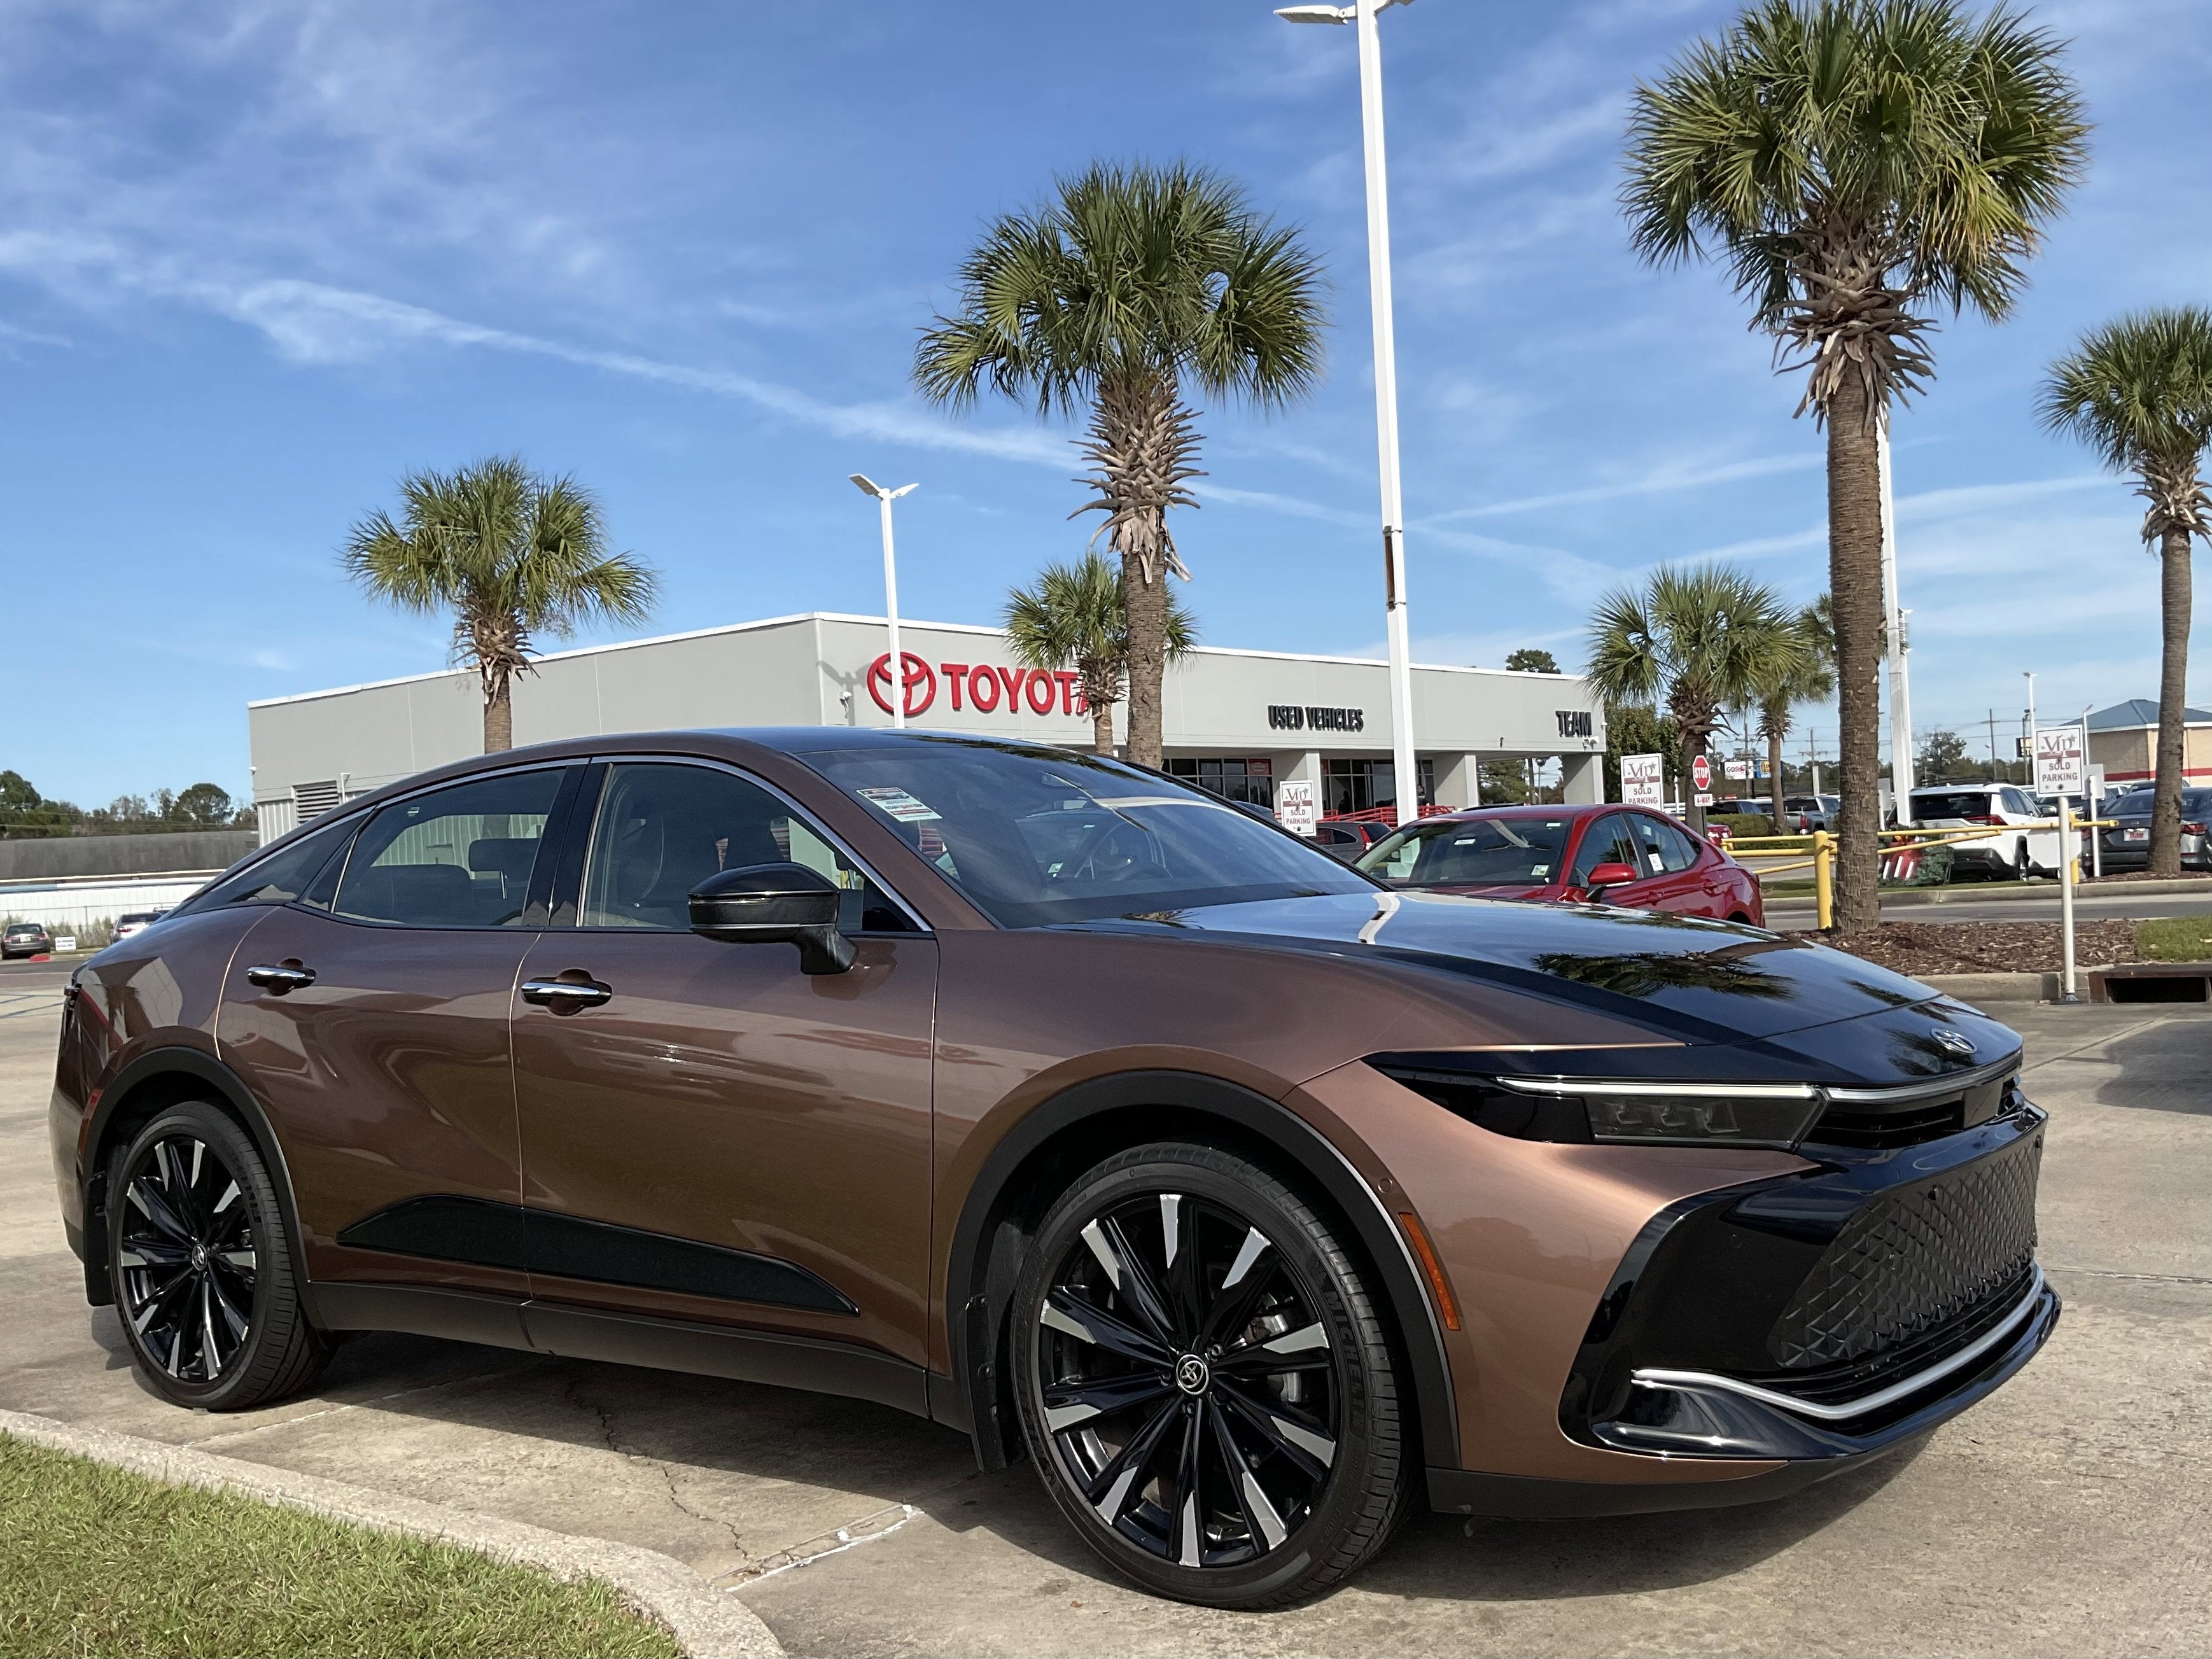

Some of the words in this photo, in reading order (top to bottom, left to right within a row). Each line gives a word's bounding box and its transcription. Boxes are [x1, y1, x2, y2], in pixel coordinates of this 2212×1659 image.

[941, 663, 1089, 714] TOYOT
[1268, 705, 1304, 730] USED
[1305, 706, 1364, 732] VEHICLES
[1555, 710, 1592, 738] TEAM
[1695, 767, 1708, 778] STOP
[2042, 773, 2078, 781] PARKING
[2049, 762, 2070, 771] SOLD
[1324, 1291, 1364, 1428] MICHELIN
